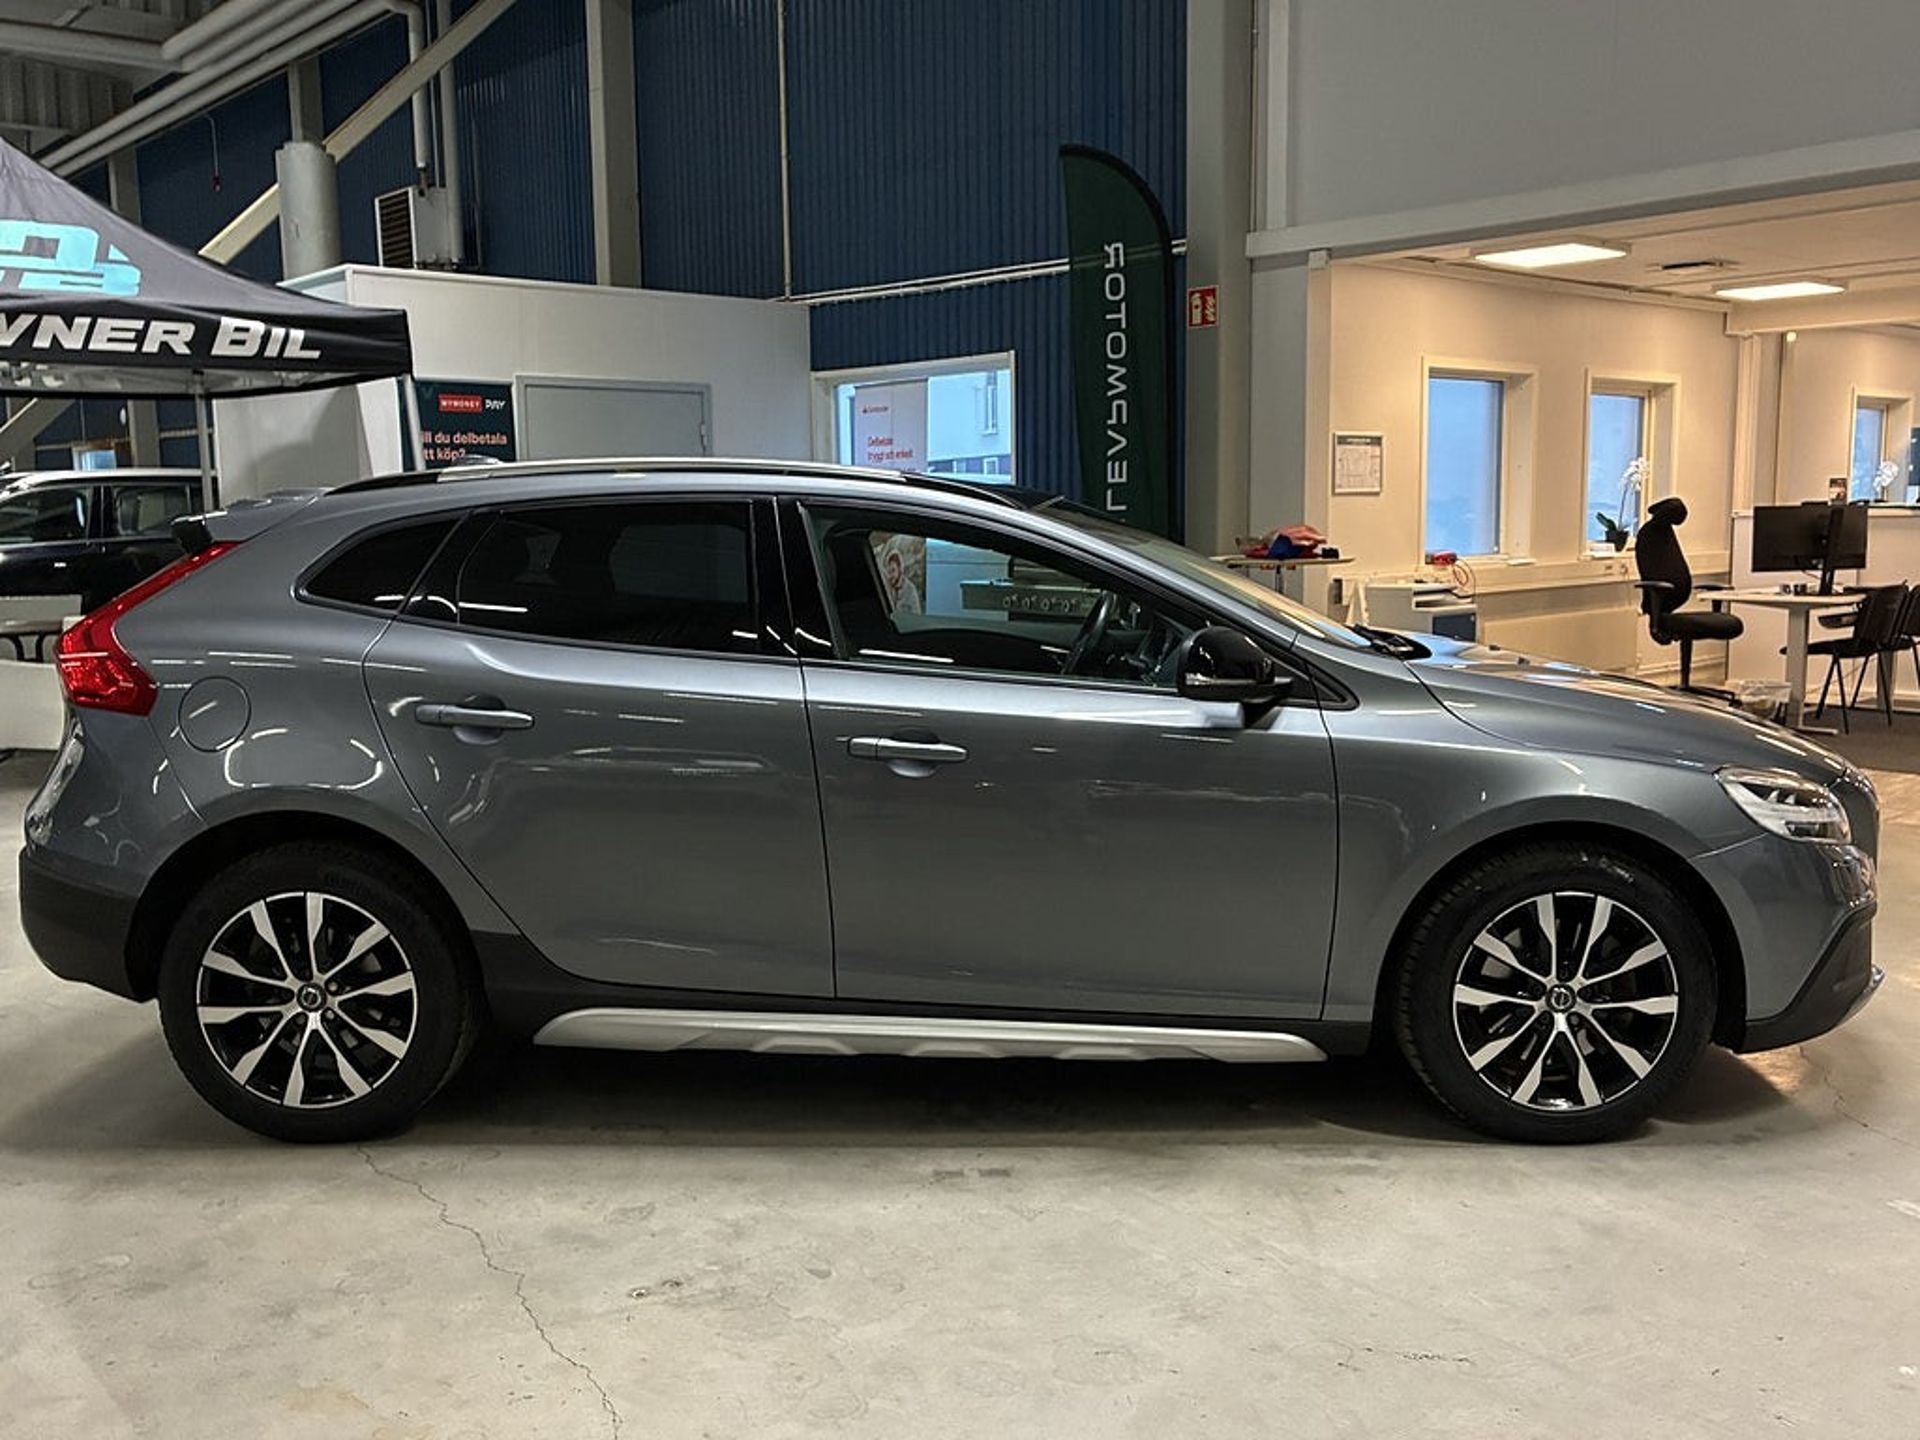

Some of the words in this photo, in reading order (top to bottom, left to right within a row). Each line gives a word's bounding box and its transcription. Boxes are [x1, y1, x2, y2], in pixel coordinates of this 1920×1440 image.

[210, 315, 322, 359] BIL
[422, 431, 432, 443] ill
[434, 431, 451, 444] du
[453, 432, 508, 445] delbetala
